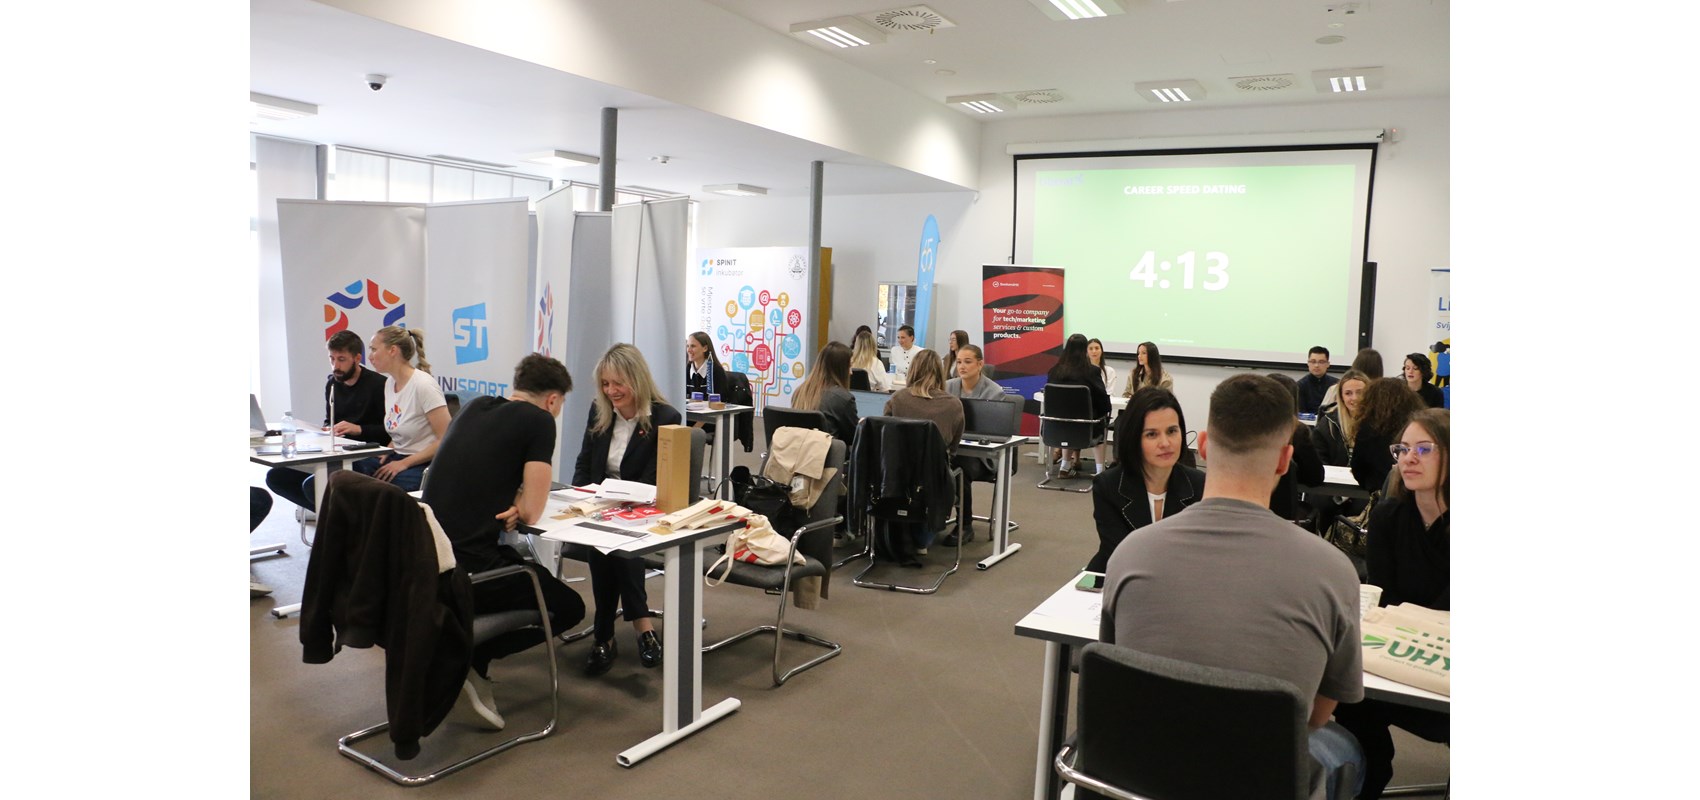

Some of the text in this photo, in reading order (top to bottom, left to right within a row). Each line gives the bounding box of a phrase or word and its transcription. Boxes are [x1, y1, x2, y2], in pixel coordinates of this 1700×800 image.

[1124, 184, 1246, 195] CAREER SPEED DATING
[1129, 250, 1230, 291] 4:13
[992, 315, 1046, 325] for tech/marketing
[453, 318, 488, 348] ST
[438, 375, 508, 397] NISPORT
